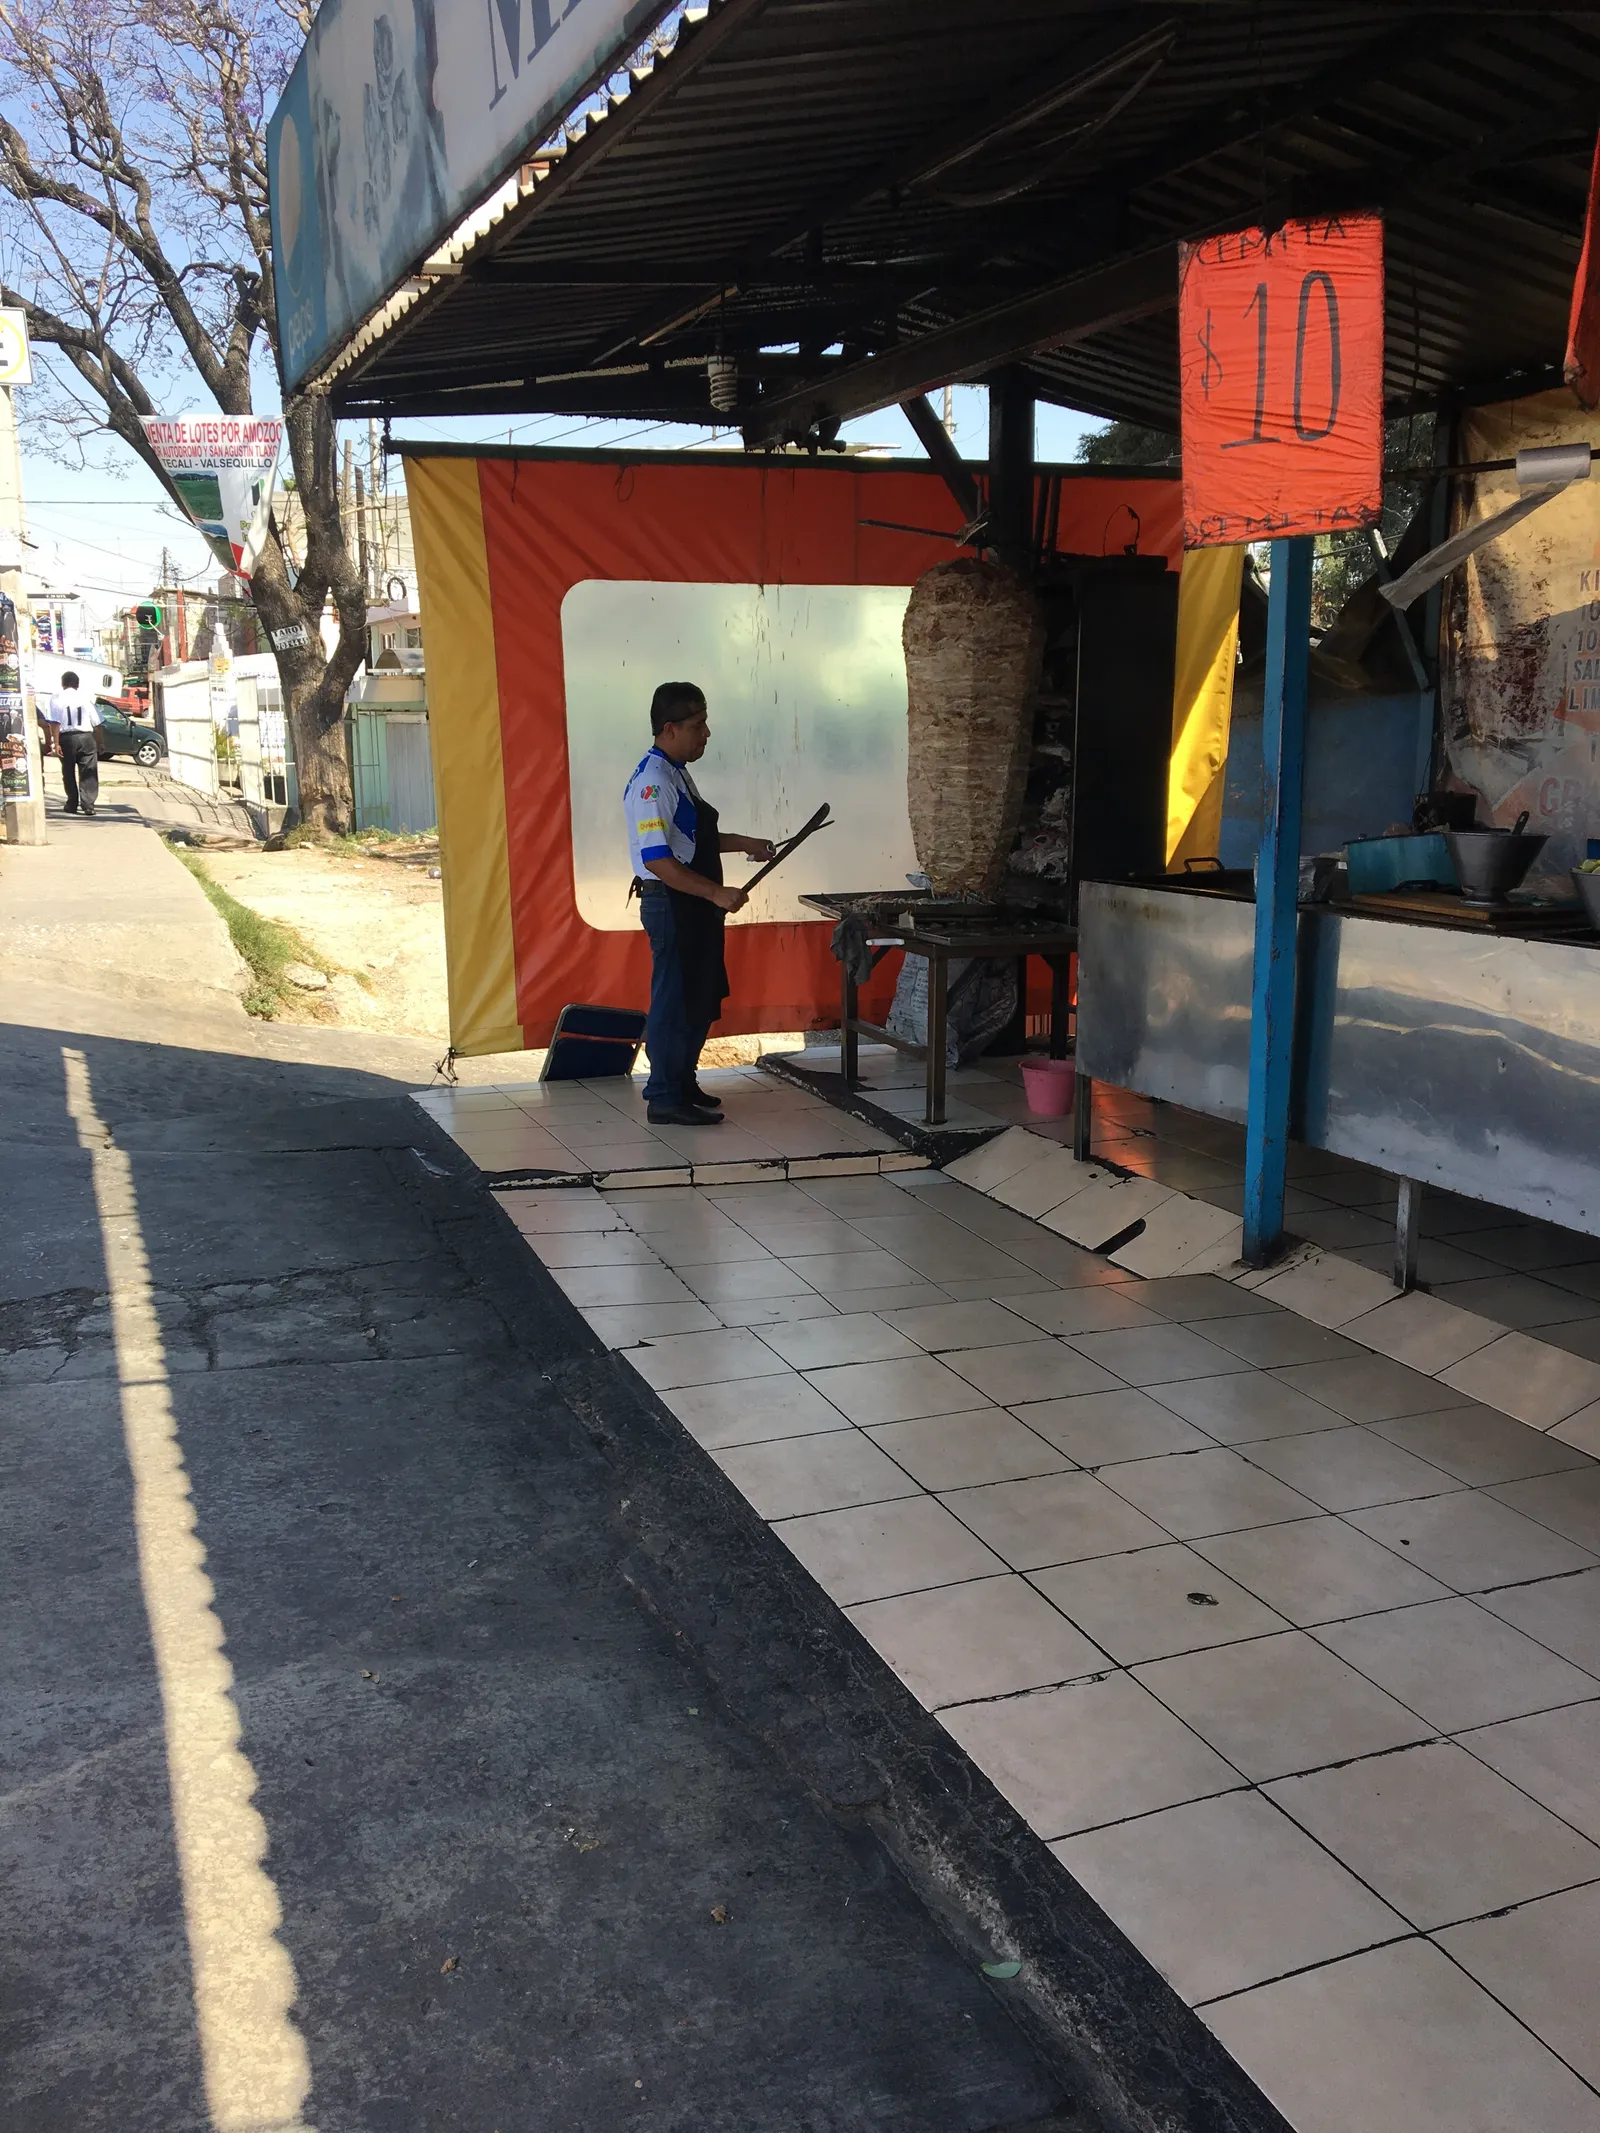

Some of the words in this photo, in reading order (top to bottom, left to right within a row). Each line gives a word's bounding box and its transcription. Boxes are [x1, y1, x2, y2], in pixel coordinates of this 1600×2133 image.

[288, 290, 316, 370] pepsi
[144, 423, 173, 444] VENTA
[175, 423, 187, 443] DE
[189, 423, 219, 443] LOTES
[221, 423, 241, 443] POR
[243, 422, 282, 443] AMOZOC
[153, 446, 163, 457] OR
[163, 446, 202, 457] AUTODROMO
[203, 446, 208, 457] Y
[209, 445, 224, 457] SAN
[162, 459, 193, 469] TECALI
[200, 458, 273, 469] VALSEQUILLO
[271, 624, 305, 638] TAROT
[66, 705, 82, 726] 11
[640, 819, 665, 830] Elekt
